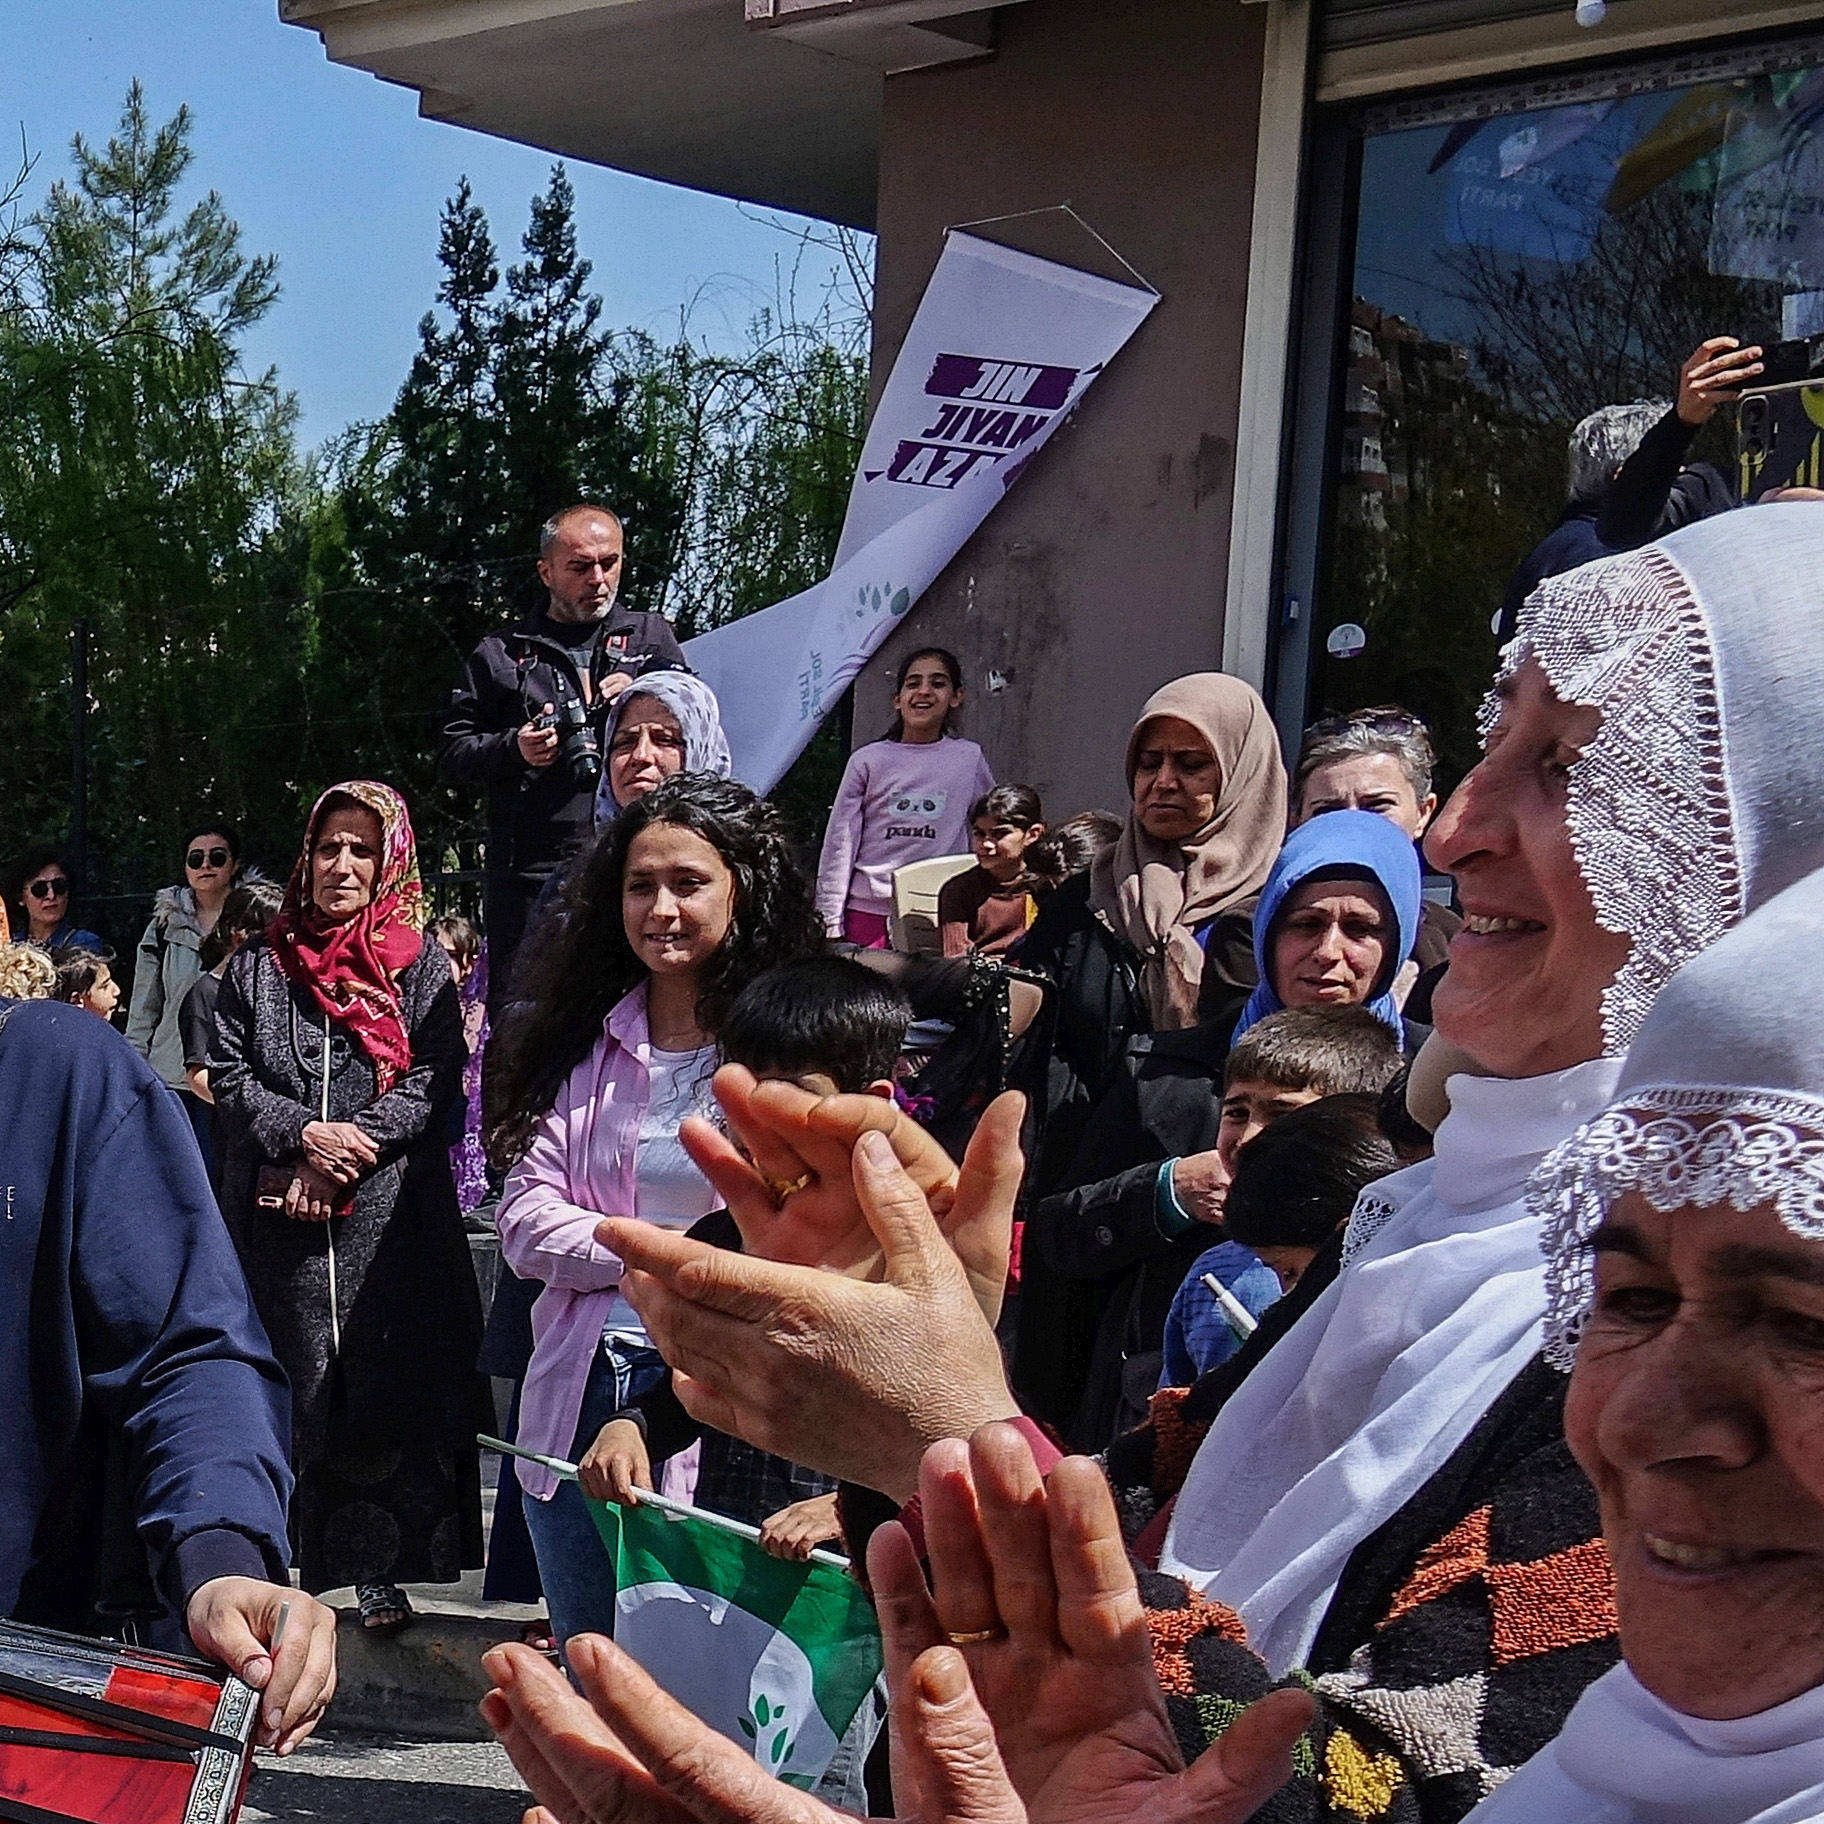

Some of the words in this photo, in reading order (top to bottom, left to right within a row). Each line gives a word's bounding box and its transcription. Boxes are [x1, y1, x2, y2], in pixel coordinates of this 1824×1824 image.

[960, 362, 1043, 403] JIN
[921, 403, 1051, 449] JIYAN
[896, 447, 997, 489] AZA
